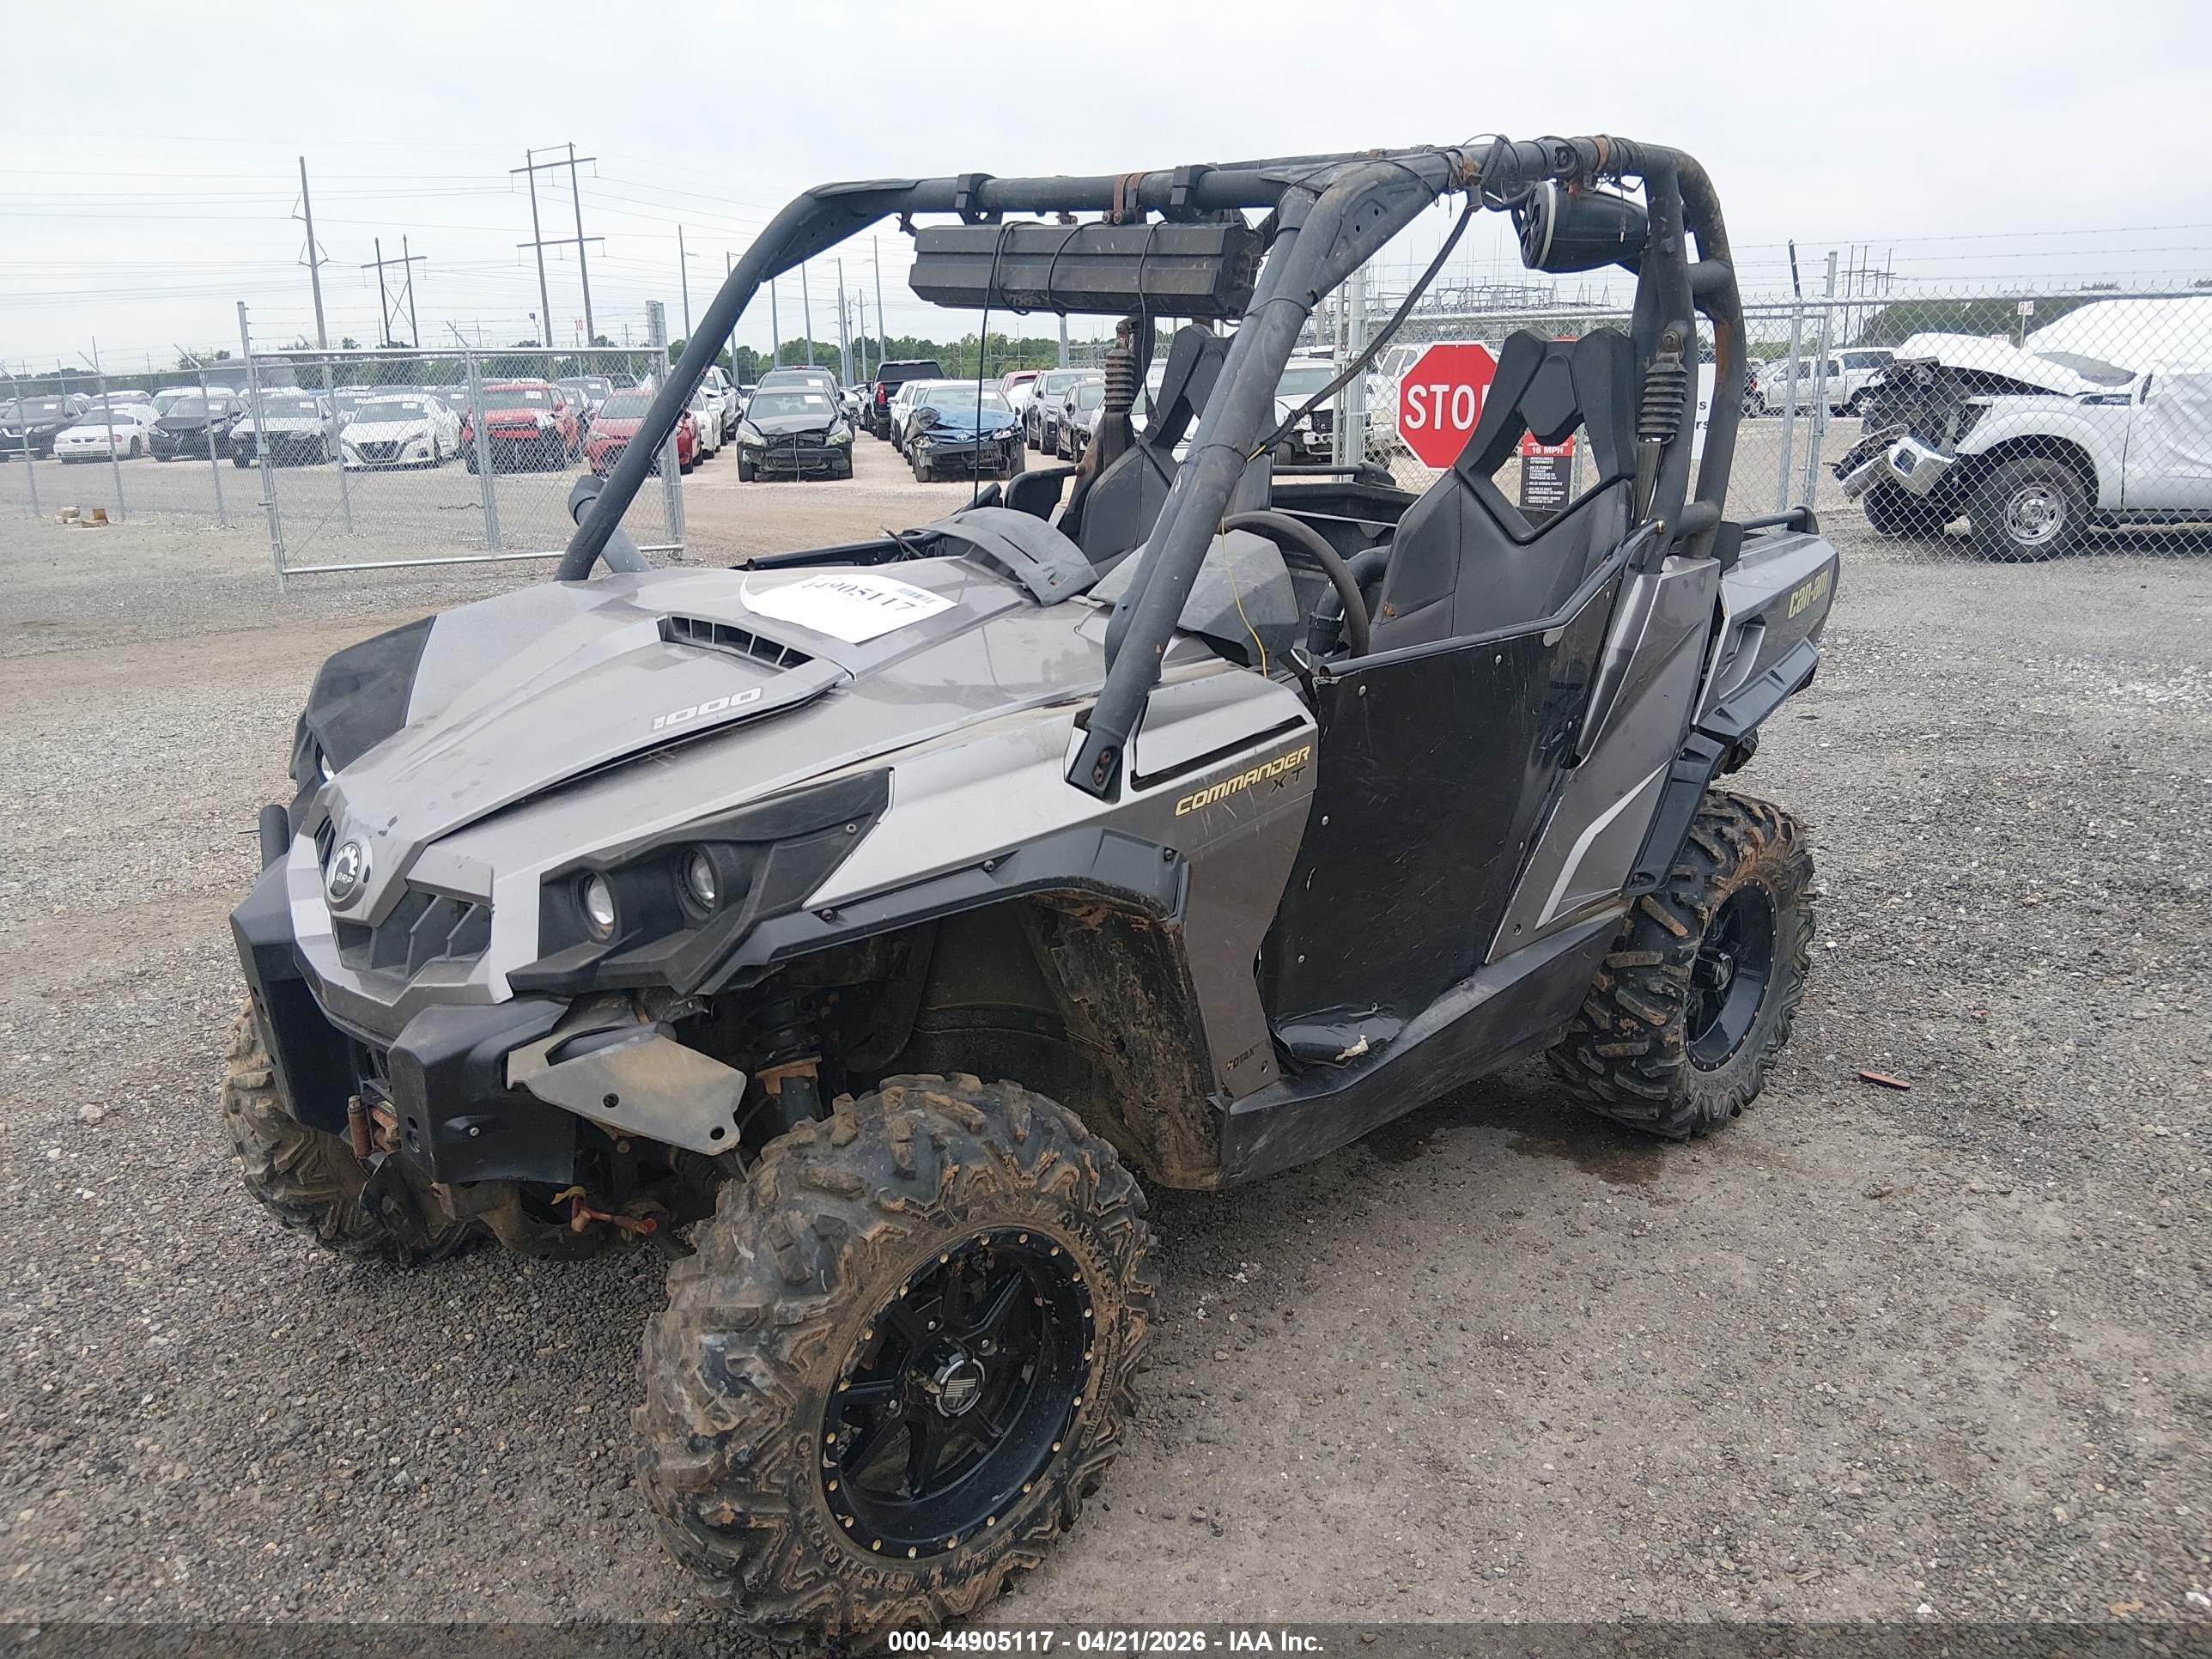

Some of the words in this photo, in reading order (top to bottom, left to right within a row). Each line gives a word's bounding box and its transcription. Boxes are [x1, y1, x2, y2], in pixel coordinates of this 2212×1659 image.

[652, 687, 762, 730] 1000
[1175, 744, 1311, 817] COMMANDER
[336, 872, 353, 884] BRP
